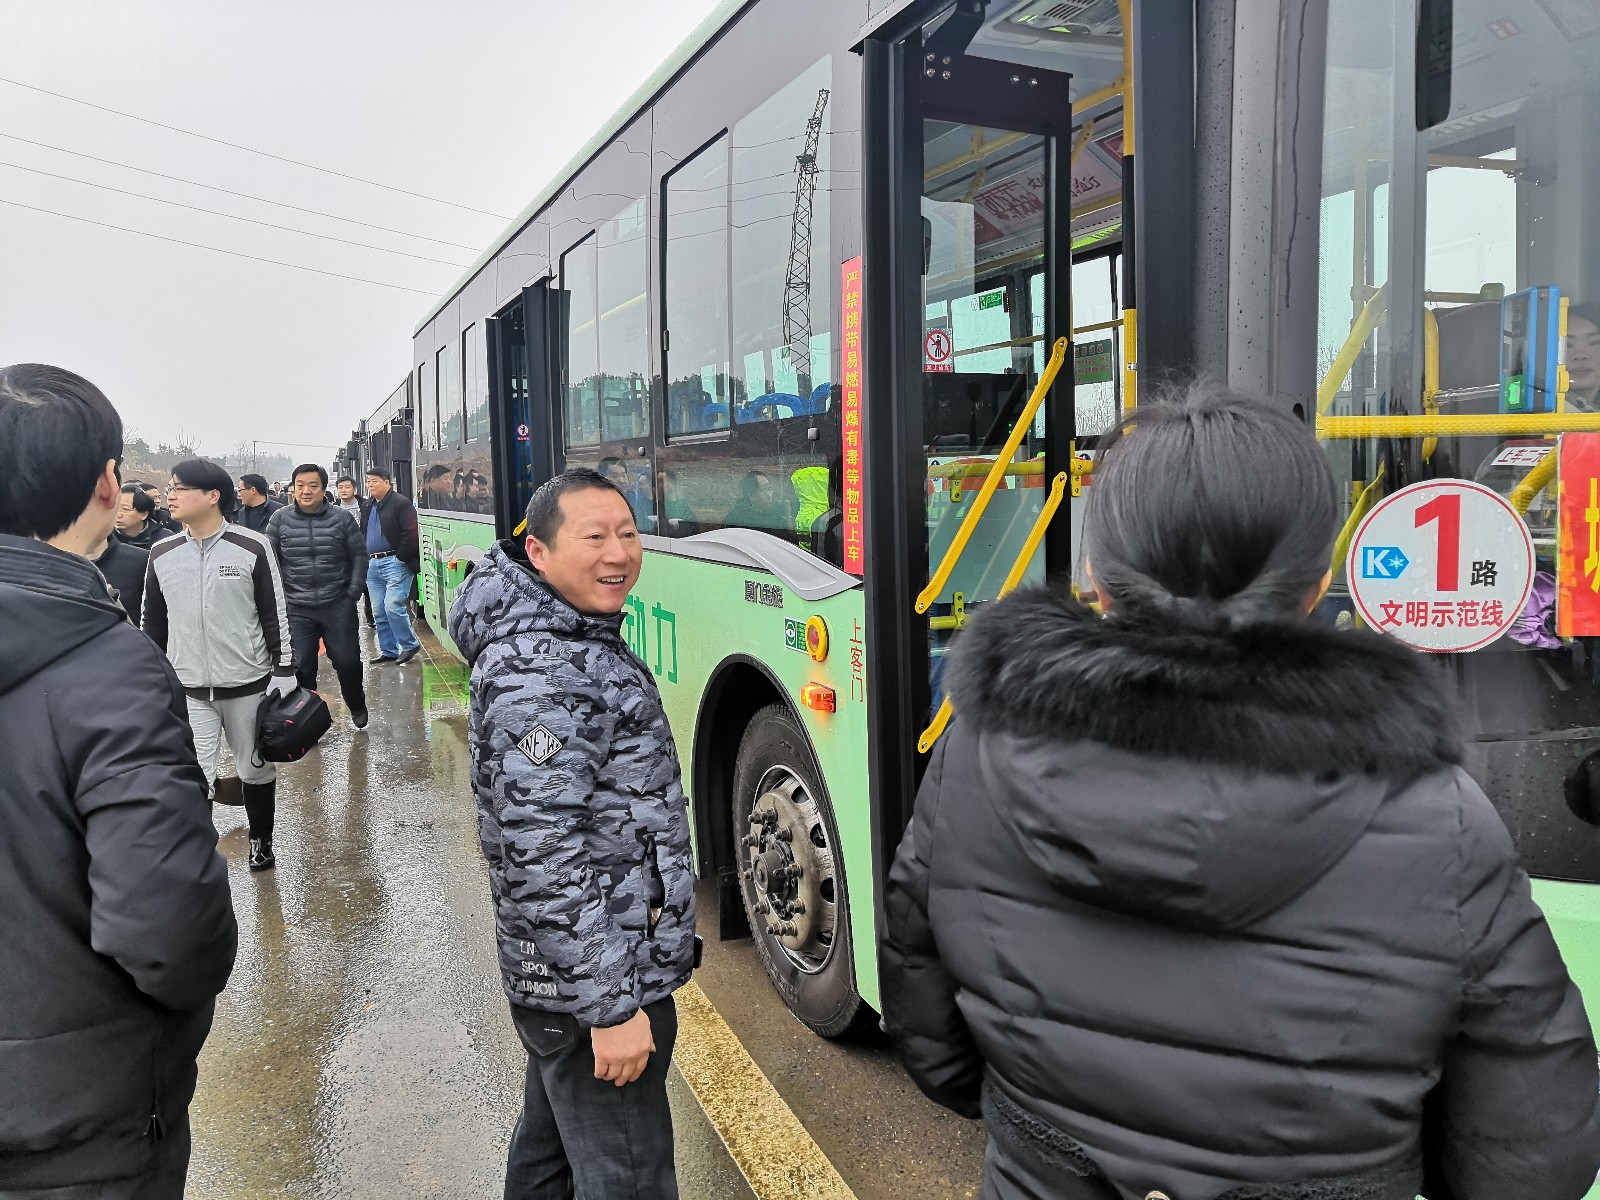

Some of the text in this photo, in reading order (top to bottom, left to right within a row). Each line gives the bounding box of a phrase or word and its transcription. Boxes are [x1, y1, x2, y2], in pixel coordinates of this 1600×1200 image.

[845, 270, 860, 562] 严禁携带易燃易爆有毒等物品上车
[1366, 549, 1391, 576] K
[1414, 493, 1498, 592] 1 路
[1379, 599, 1504, 628] 文明示范线
[850, 617, 864, 703] 上客门
[522, 979, 558, 997] UNION
